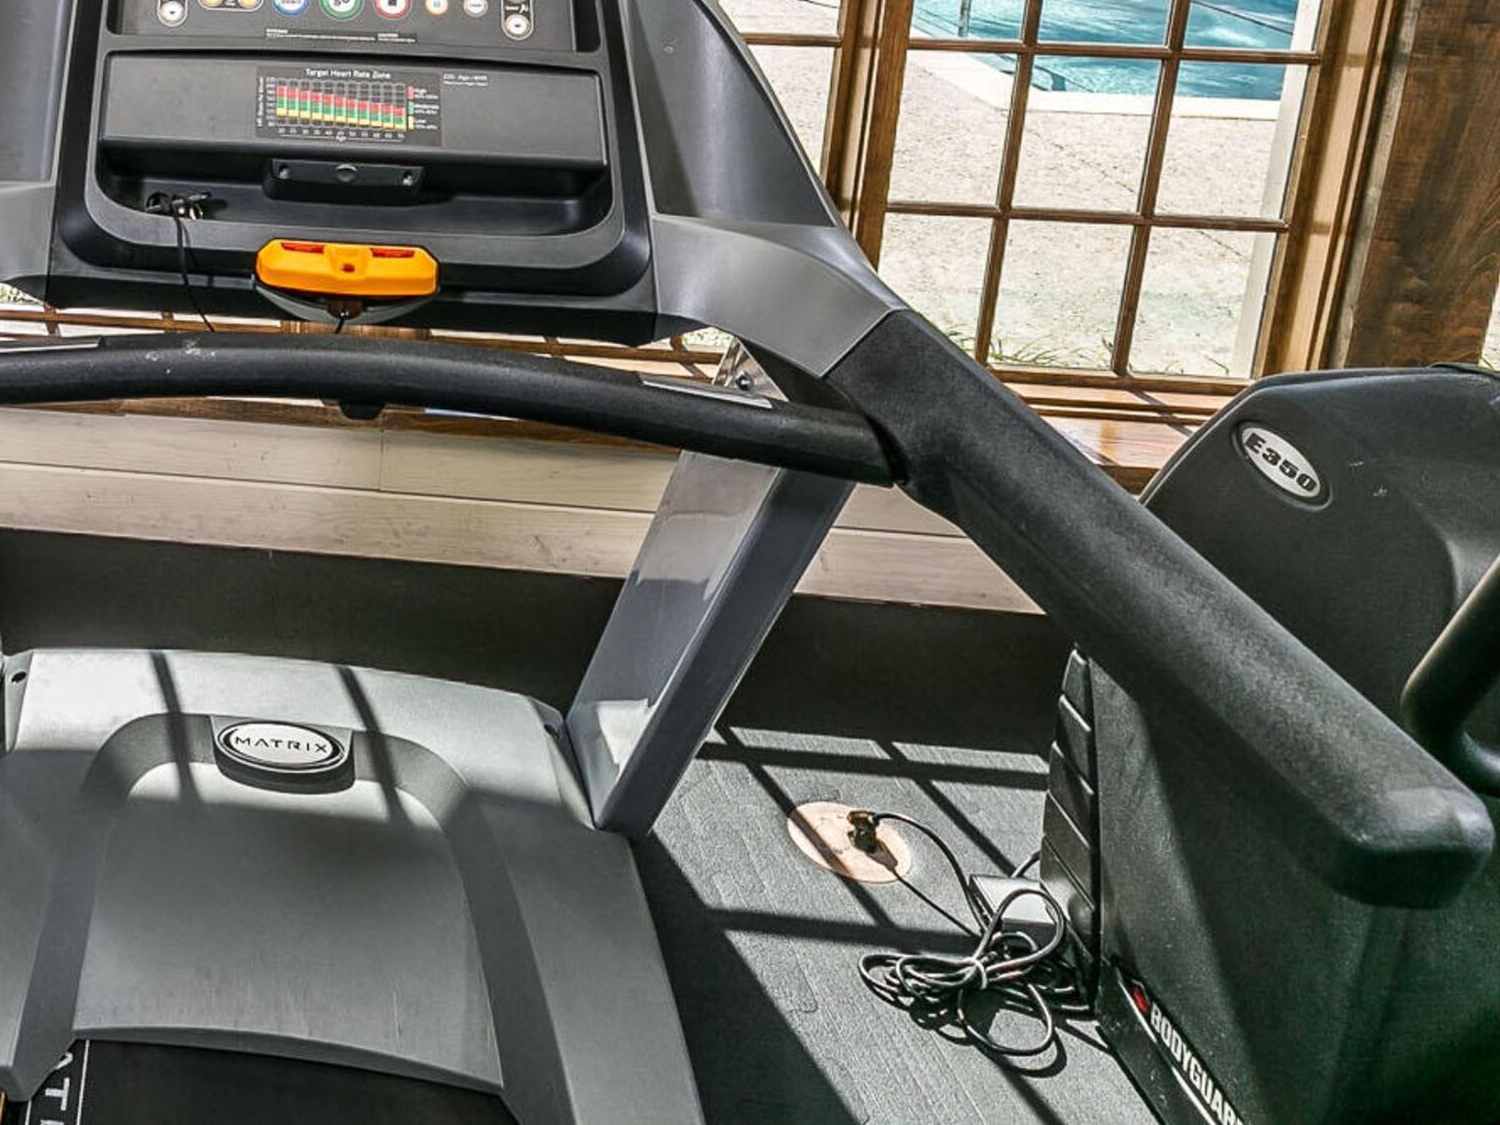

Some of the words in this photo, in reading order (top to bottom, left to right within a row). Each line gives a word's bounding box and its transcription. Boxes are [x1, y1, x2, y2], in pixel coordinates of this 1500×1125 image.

[305, 68, 329, 78] Target
[330, 69, 352, 78] Heart
[353, 70, 371, 78] Rate
[372, 71, 391, 79] Zone
[1244, 432, 1318, 492] E350
[234, 736, 328, 754] MATRIX
[1150, 1001, 1245, 1125] BODYGUAR
